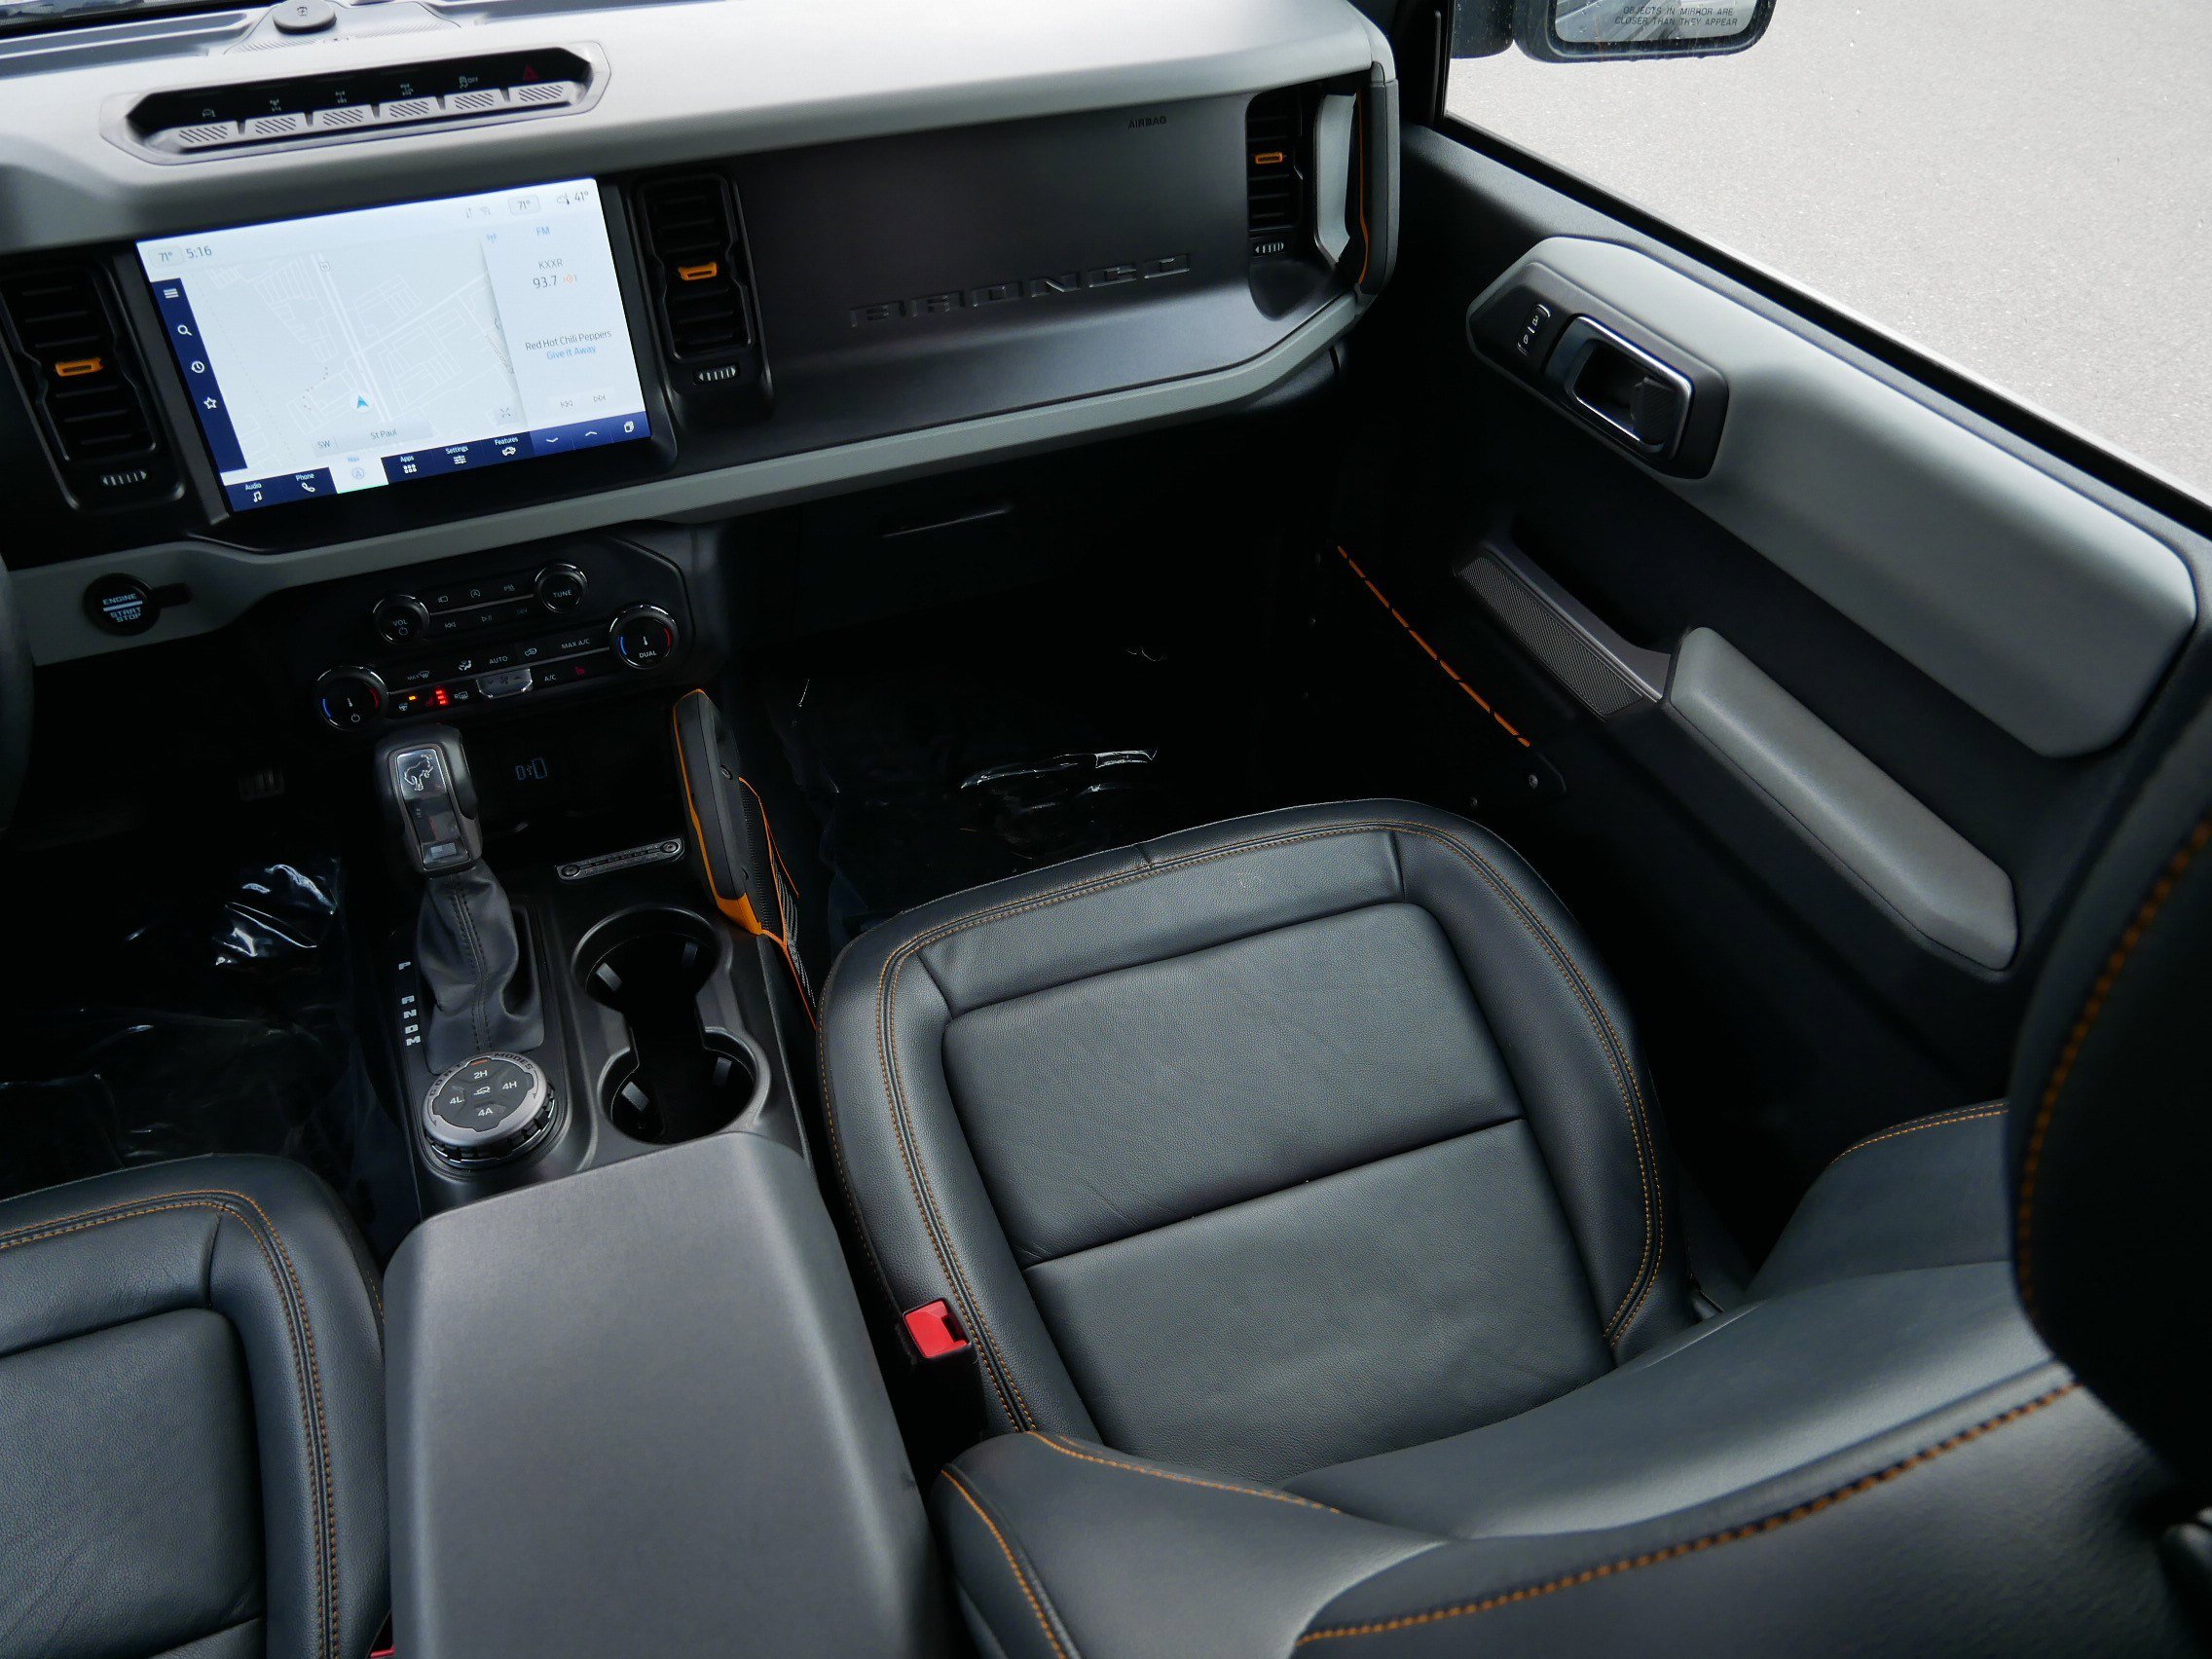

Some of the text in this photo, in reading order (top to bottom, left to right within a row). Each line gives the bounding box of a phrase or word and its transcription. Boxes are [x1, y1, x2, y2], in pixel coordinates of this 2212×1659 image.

[1623, 6, 1662, 15] OBJECTS
[1679, 7, 1714, 16] MIRROR
[1716, 8, 1733, 17] ARE
[1614, 16, 1738, 26] CLOSER THAN THEY APPEAR
[1128, 116, 1167, 129] AIRBAG
[536, 226, 550, 236] FM
[186, 245, 212, 260] 5:16
[537, 258, 564, 271] KXXR
[533, 276, 557, 289] 93.7
[848, 253, 1191, 327] BRONCO
[525, 330, 612, 350] Red Hot Chili Peppers
[546, 350, 566, 360] Give
[574, 345, 597, 355] Away
[370, 428, 397, 440] St Paul
[317, 440, 331, 449] SW
[495, 436, 519, 446] Features
[445, 445, 469, 455] Settings
[295, 473, 314, 482] Phone
[244, 482, 262, 491] Audio
[553, 589, 572, 599] TUNE
[102, 593, 137, 606] ENGINE
[110, 607, 141, 619] START
[117, 612, 142, 623] STOP
[392, 618, 408, 627] VOL
[561, 638, 592, 650] MAX A/C
[639, 649, 658, 659] DUAL
[489, 655, 509, 665] AUTO
[544, 674, 557, 683] A/C
[398, 961, 412, 971] P
[403, 1009, 417, 1019] N
[405, 1024, 419, 1034] D
[406, 1035, 421, 1047] M
[494, 1052, 534, 1070] MODES
[473, 1069, 488, 1080] 2H
[501, 1081, 518, 1090] 4H
[449, 1096, 463, 1105] 4L
[477, 1108, 494, 1117] 4A
